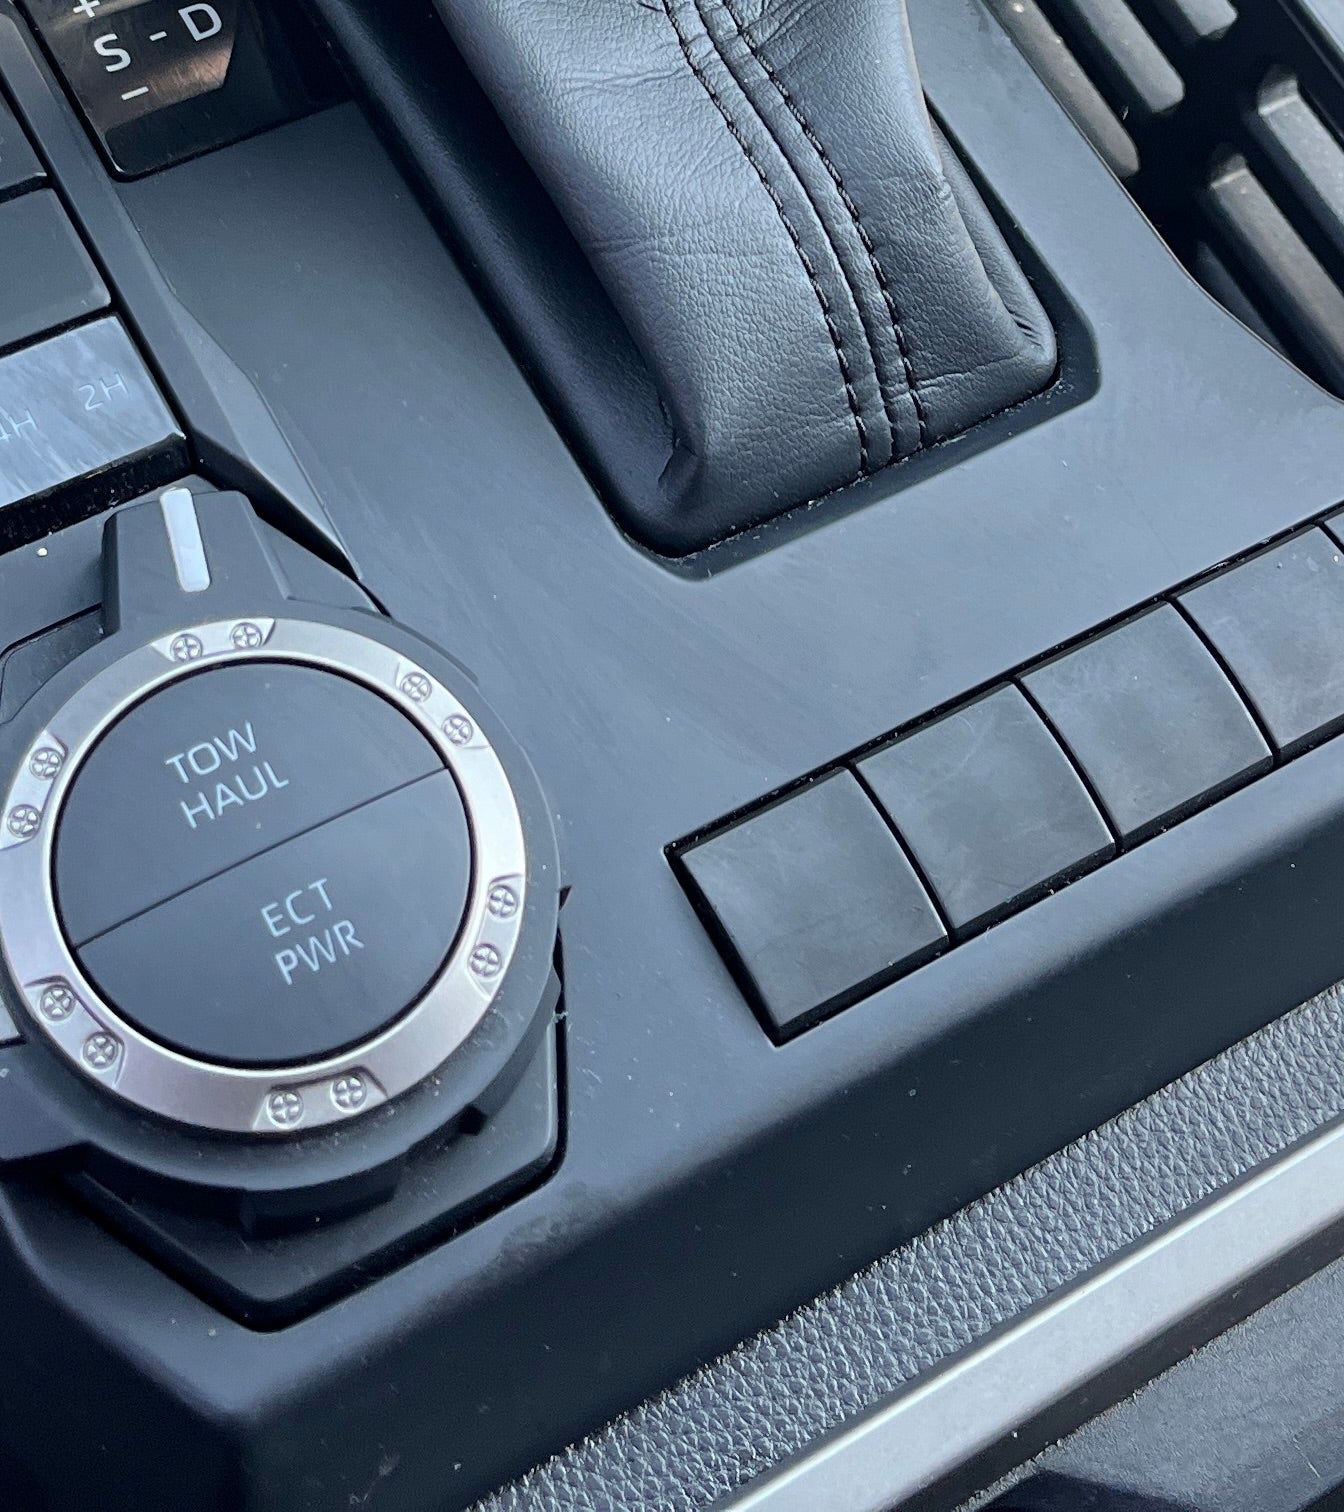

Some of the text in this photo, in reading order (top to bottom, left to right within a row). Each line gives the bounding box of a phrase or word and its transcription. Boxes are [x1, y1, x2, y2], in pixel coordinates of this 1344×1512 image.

[93, 33, 131, 72] S
[178, 3, 223, 42] D
[78, 371, 130, 413] 2H
[164, 720, 258, 784] TOW
[179, 761, 290, 829] HAUL
[260, 877, 333, 938] ECT
[274, 919, 365, 985] PWR
